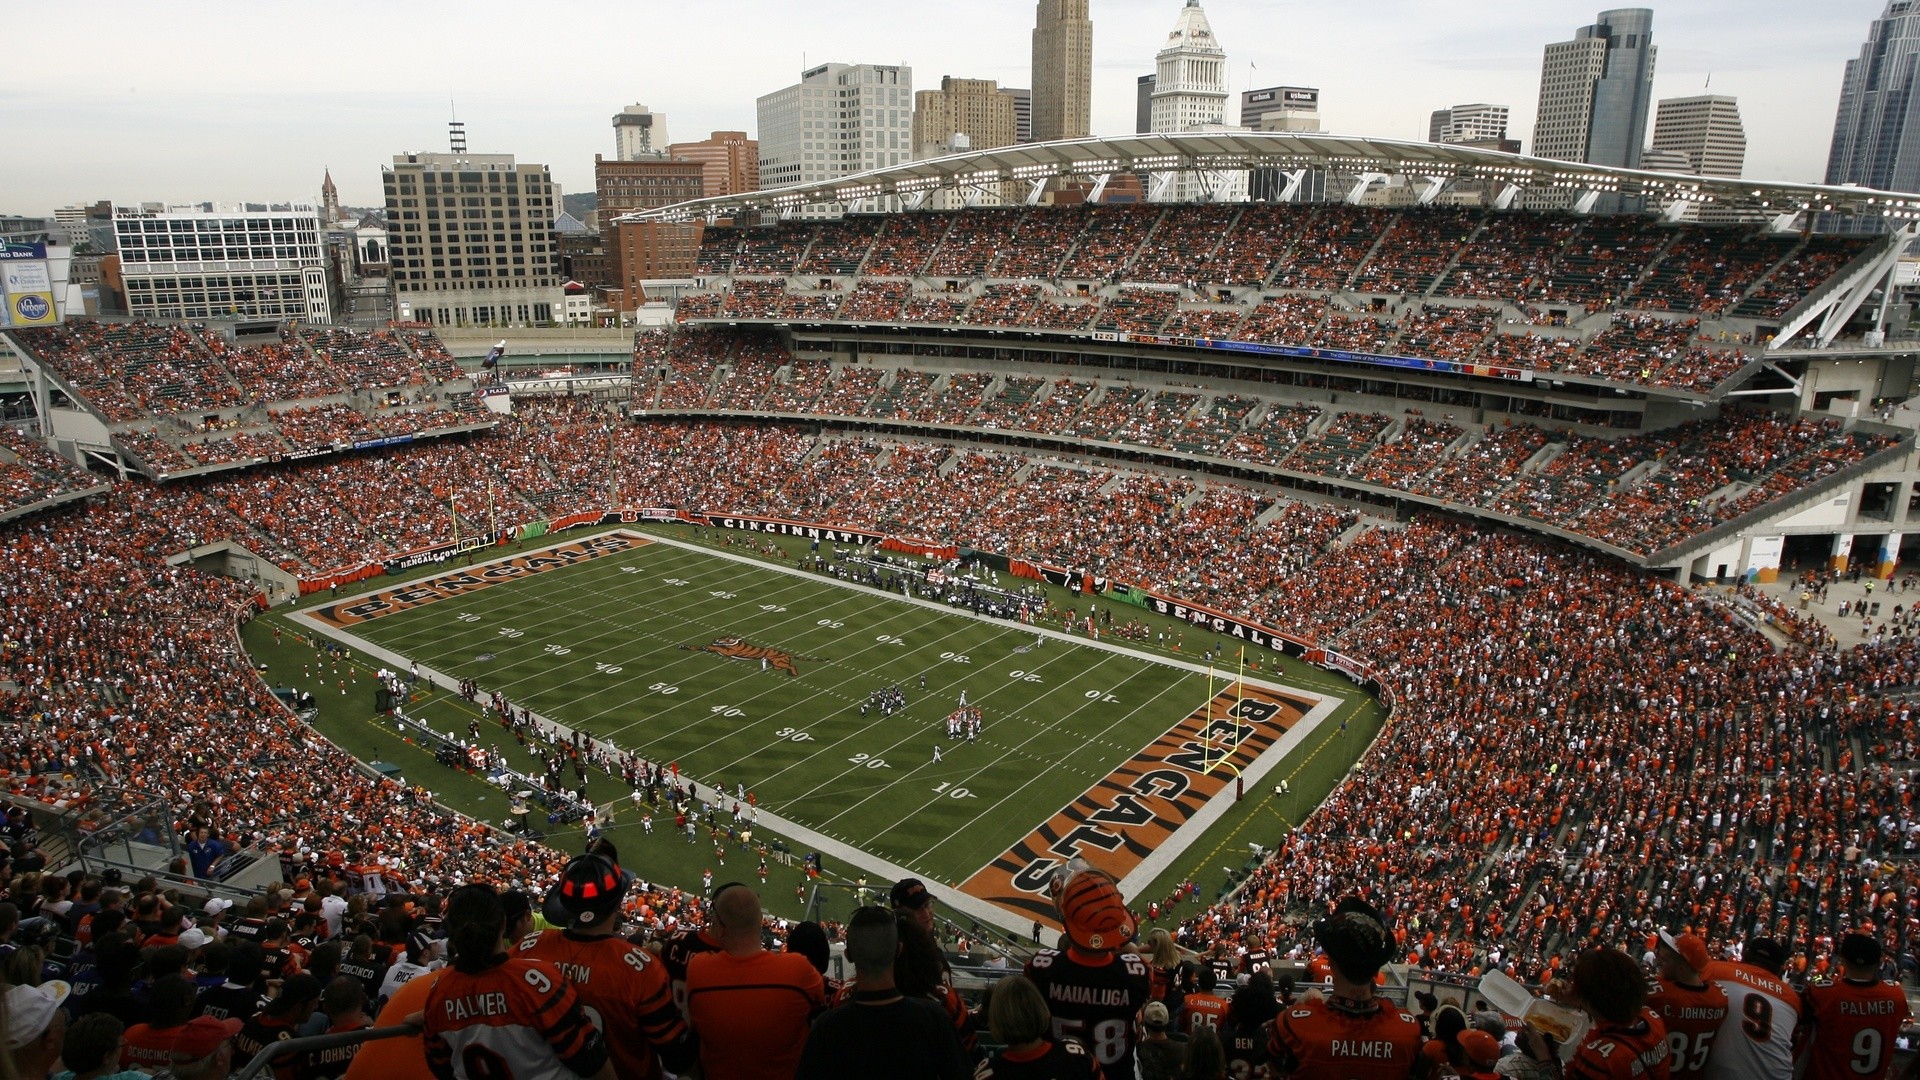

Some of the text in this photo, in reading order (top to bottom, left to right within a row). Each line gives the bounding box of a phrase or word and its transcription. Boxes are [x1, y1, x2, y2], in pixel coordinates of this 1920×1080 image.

[21, 299, 46, 317] Kroger
[290, 449, 332, 460] BENGALS.COM
[723, 519, 863, 545] CINCINNATI
[341, 538, 630, 618] BENGALS
[1155, 601, 1284, 652] BENGALS
[648, 682, 679, 696] 50
[710, 703, 742, 719] 40
[775, 727, 810, 743] 30
[847, 752, 884, 770] 20
[932, 781, 971, 800] 10
[1010, 698, 1282, 900] BENGALS
[623, 947, 652, 971] 98
[1120, 953, 1146, 976] 58
[394, 971, 413, 984] RICE
[524, 968, 552, 994] 9
[1735, 968, 1783, 995] PALMER
[1049, 981, 1130, 1006] MAUALUGA
[1196, 1000, 1221, 1009] JOHNSON
[445, 992, 508, 1021] PALMER
[1663, 1005, 1725, 1020] C. JOHNSON
[1741, 993, 1772, 1042] 9
[1839, 1000, 1895, 1016] PALMER
[1191, 1011, 1218, 1034] 85
[1051, 1015, 1127, 1065] 58
[1234, 1037, 1253, 1050] BEN
[1331, 1039, 1394, 1059] PALMER
[1849, 1027, 1883, 1075] 9
[1667, 1031, 1716, 1073] 85
